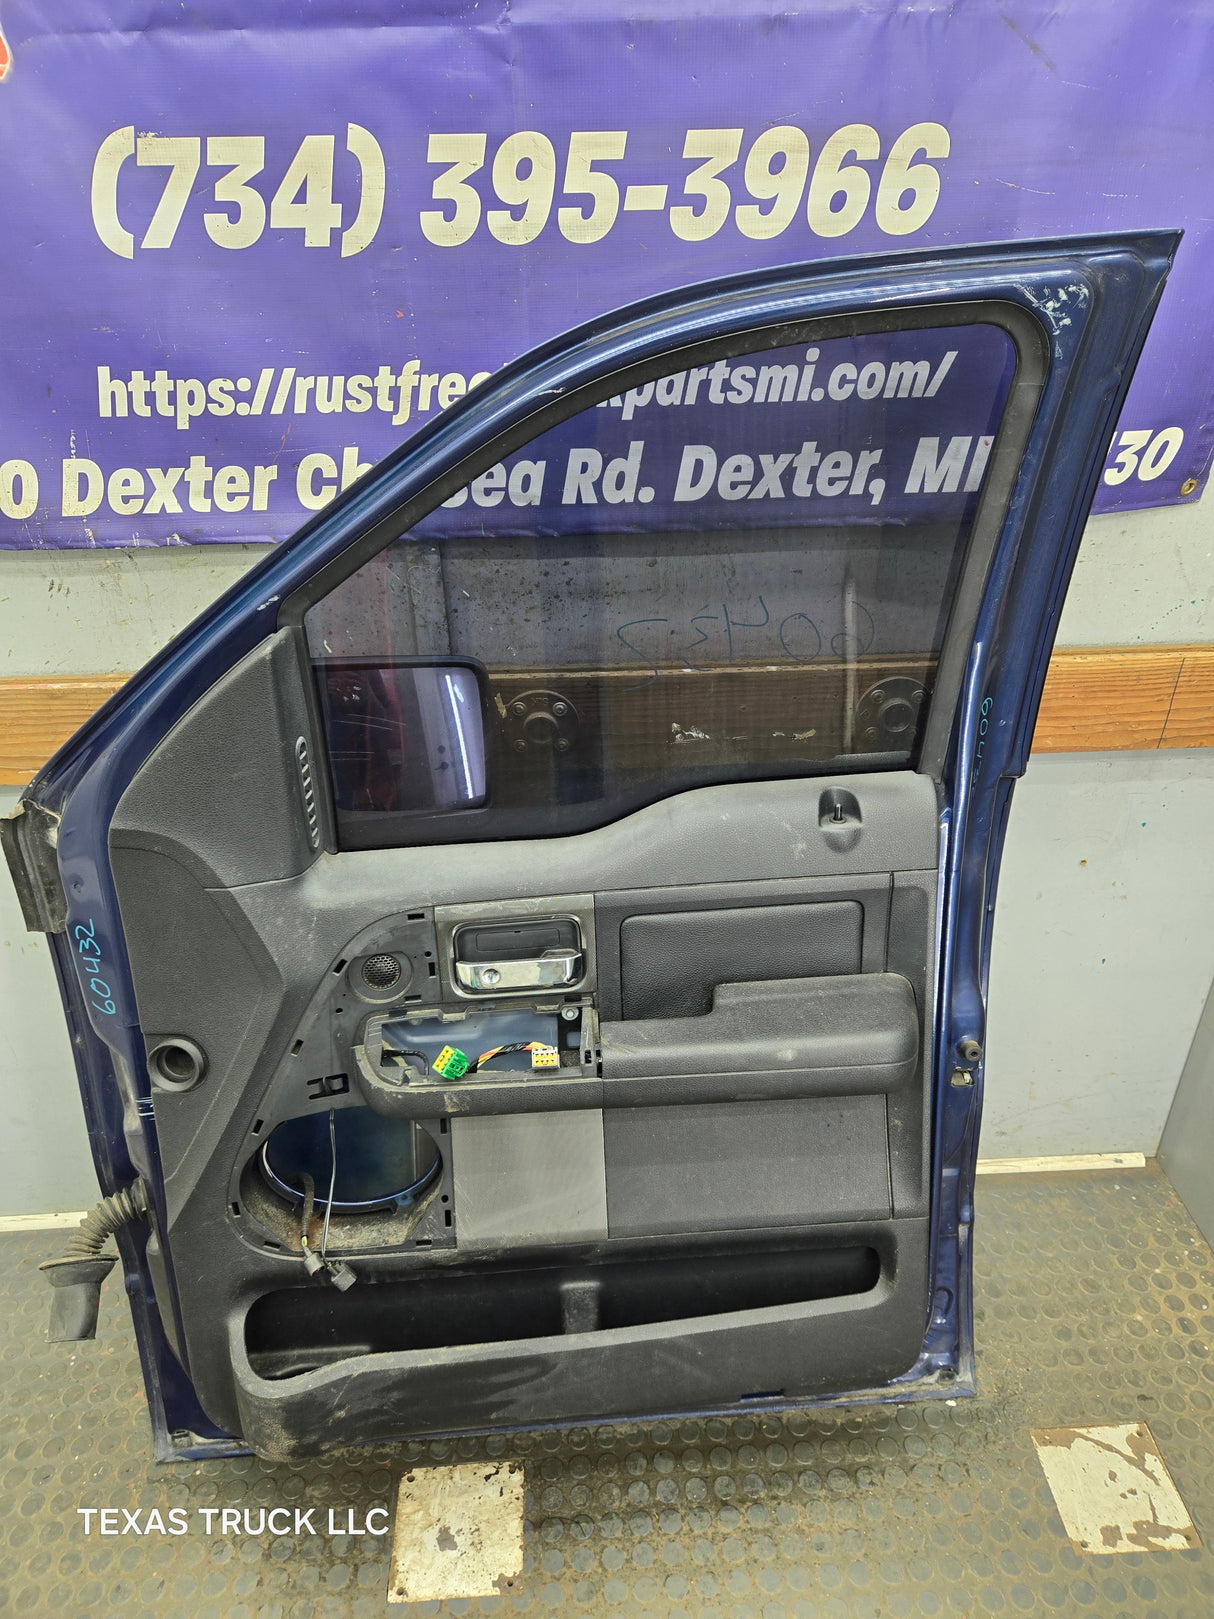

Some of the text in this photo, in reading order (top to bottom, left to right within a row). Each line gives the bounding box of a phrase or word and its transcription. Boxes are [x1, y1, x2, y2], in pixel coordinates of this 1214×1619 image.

[91, 122, 951, 259] (734) 395-3966
[97, 347, 958, 430] https://rustfrepartsmi.com/
[61, 455, 278, 517] Dexter
[296, 446, 547, 510] Chea
[561, 440, 656, 505] Rd.
[673, 440, 887, 505] Dexter,
[904, 435, 995, 493] MI
[1103, 426, 1185, 486] 30
[74, 918, 117, 1015] 60432
